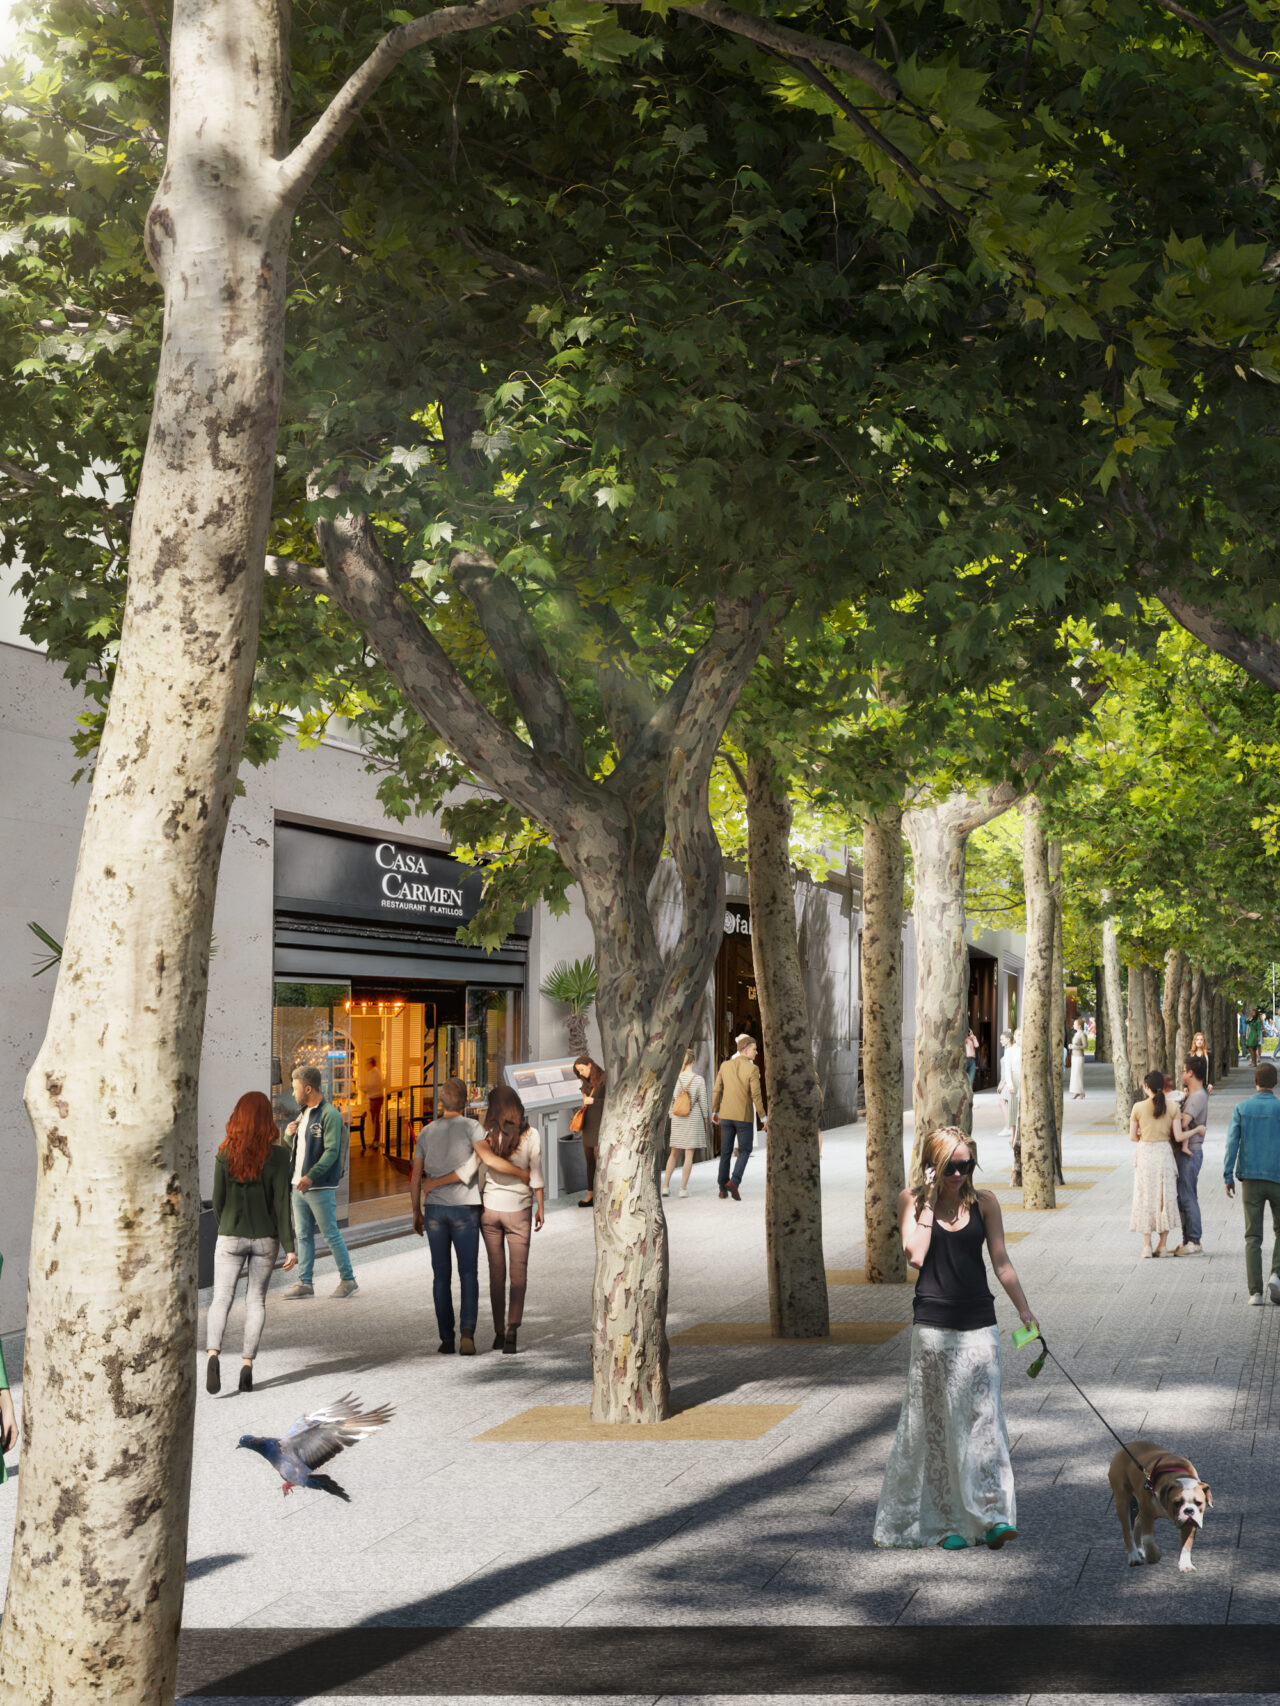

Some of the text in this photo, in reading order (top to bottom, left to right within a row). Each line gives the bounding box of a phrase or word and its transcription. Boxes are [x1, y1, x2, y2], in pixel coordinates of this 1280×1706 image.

[375, 843, 429, 875] CASA
[381, 872, 463, 906] CARMEN
[381, 899, 464, 917] RESTAURANT PLATILLOS
